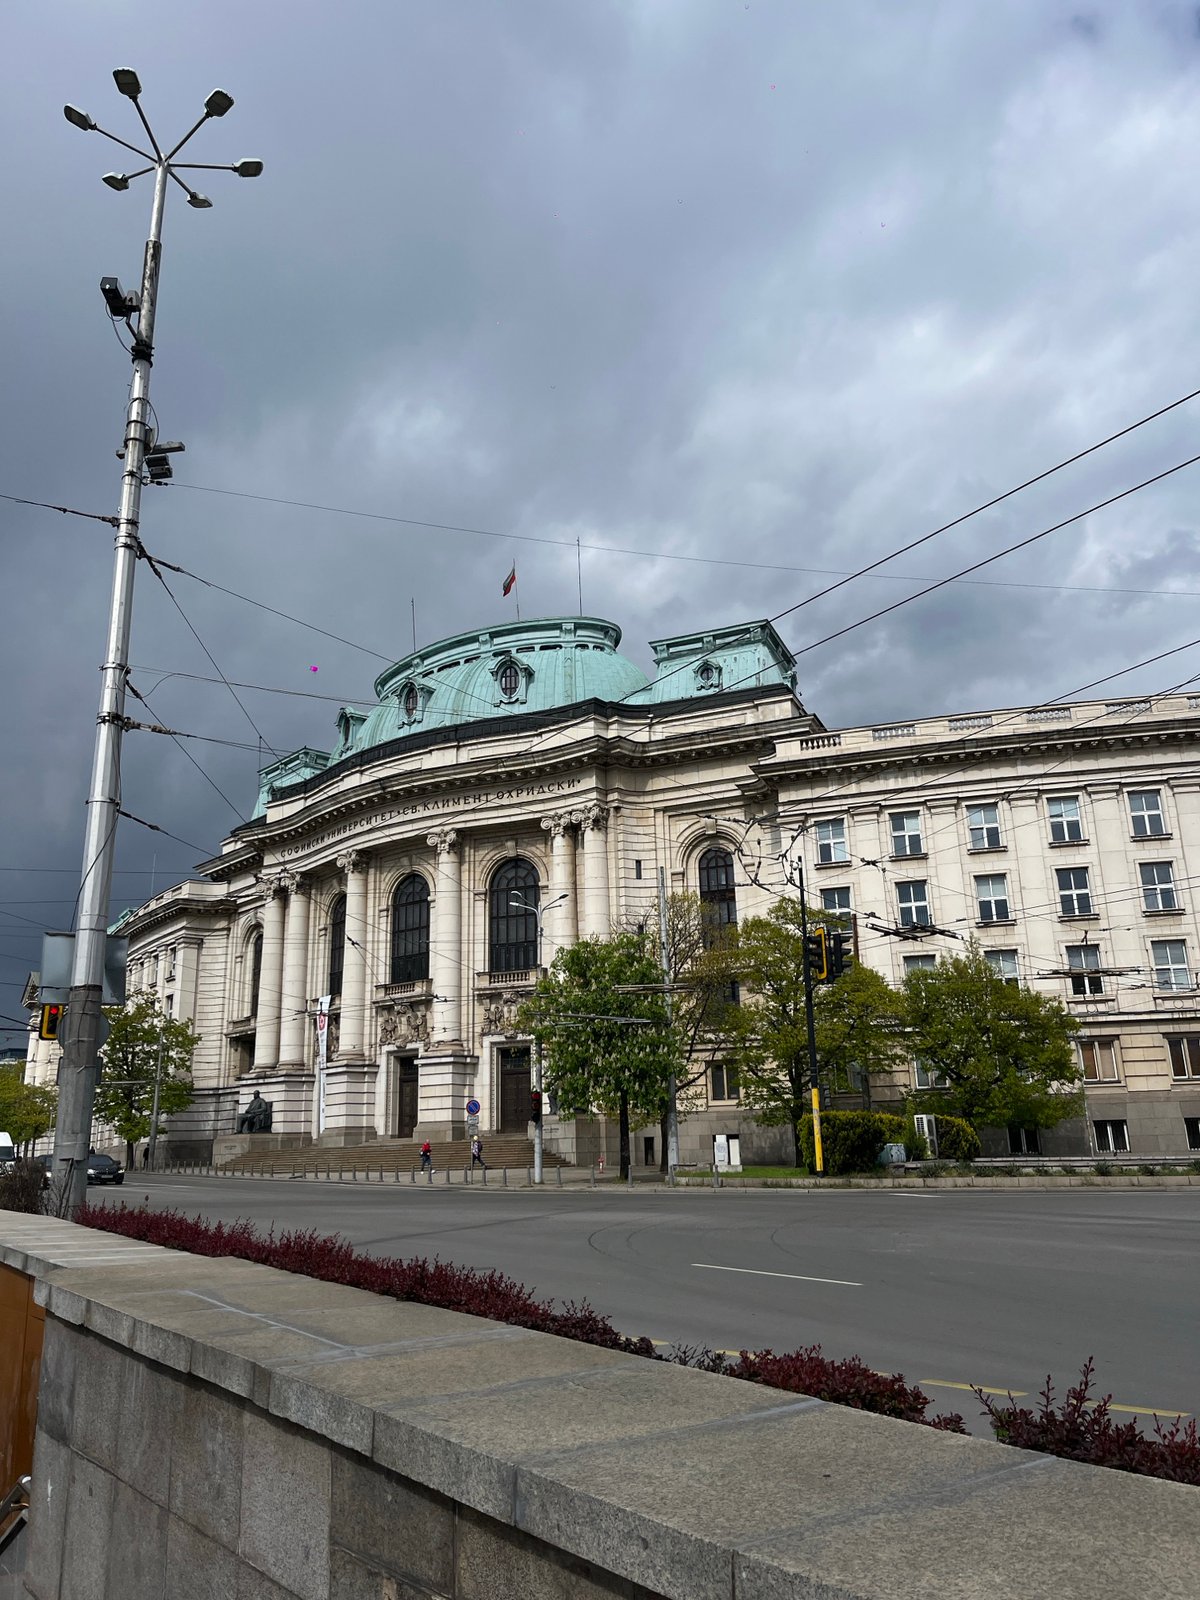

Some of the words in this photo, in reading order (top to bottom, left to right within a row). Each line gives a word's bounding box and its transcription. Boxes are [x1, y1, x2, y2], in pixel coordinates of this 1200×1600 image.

[327, 810, 394, 840] УНИВЕРСИТЕТ
[423, 792, 491, 811] КЛИМЕНТ
[496, 778, 576, 800] ОХРИДСКИ
